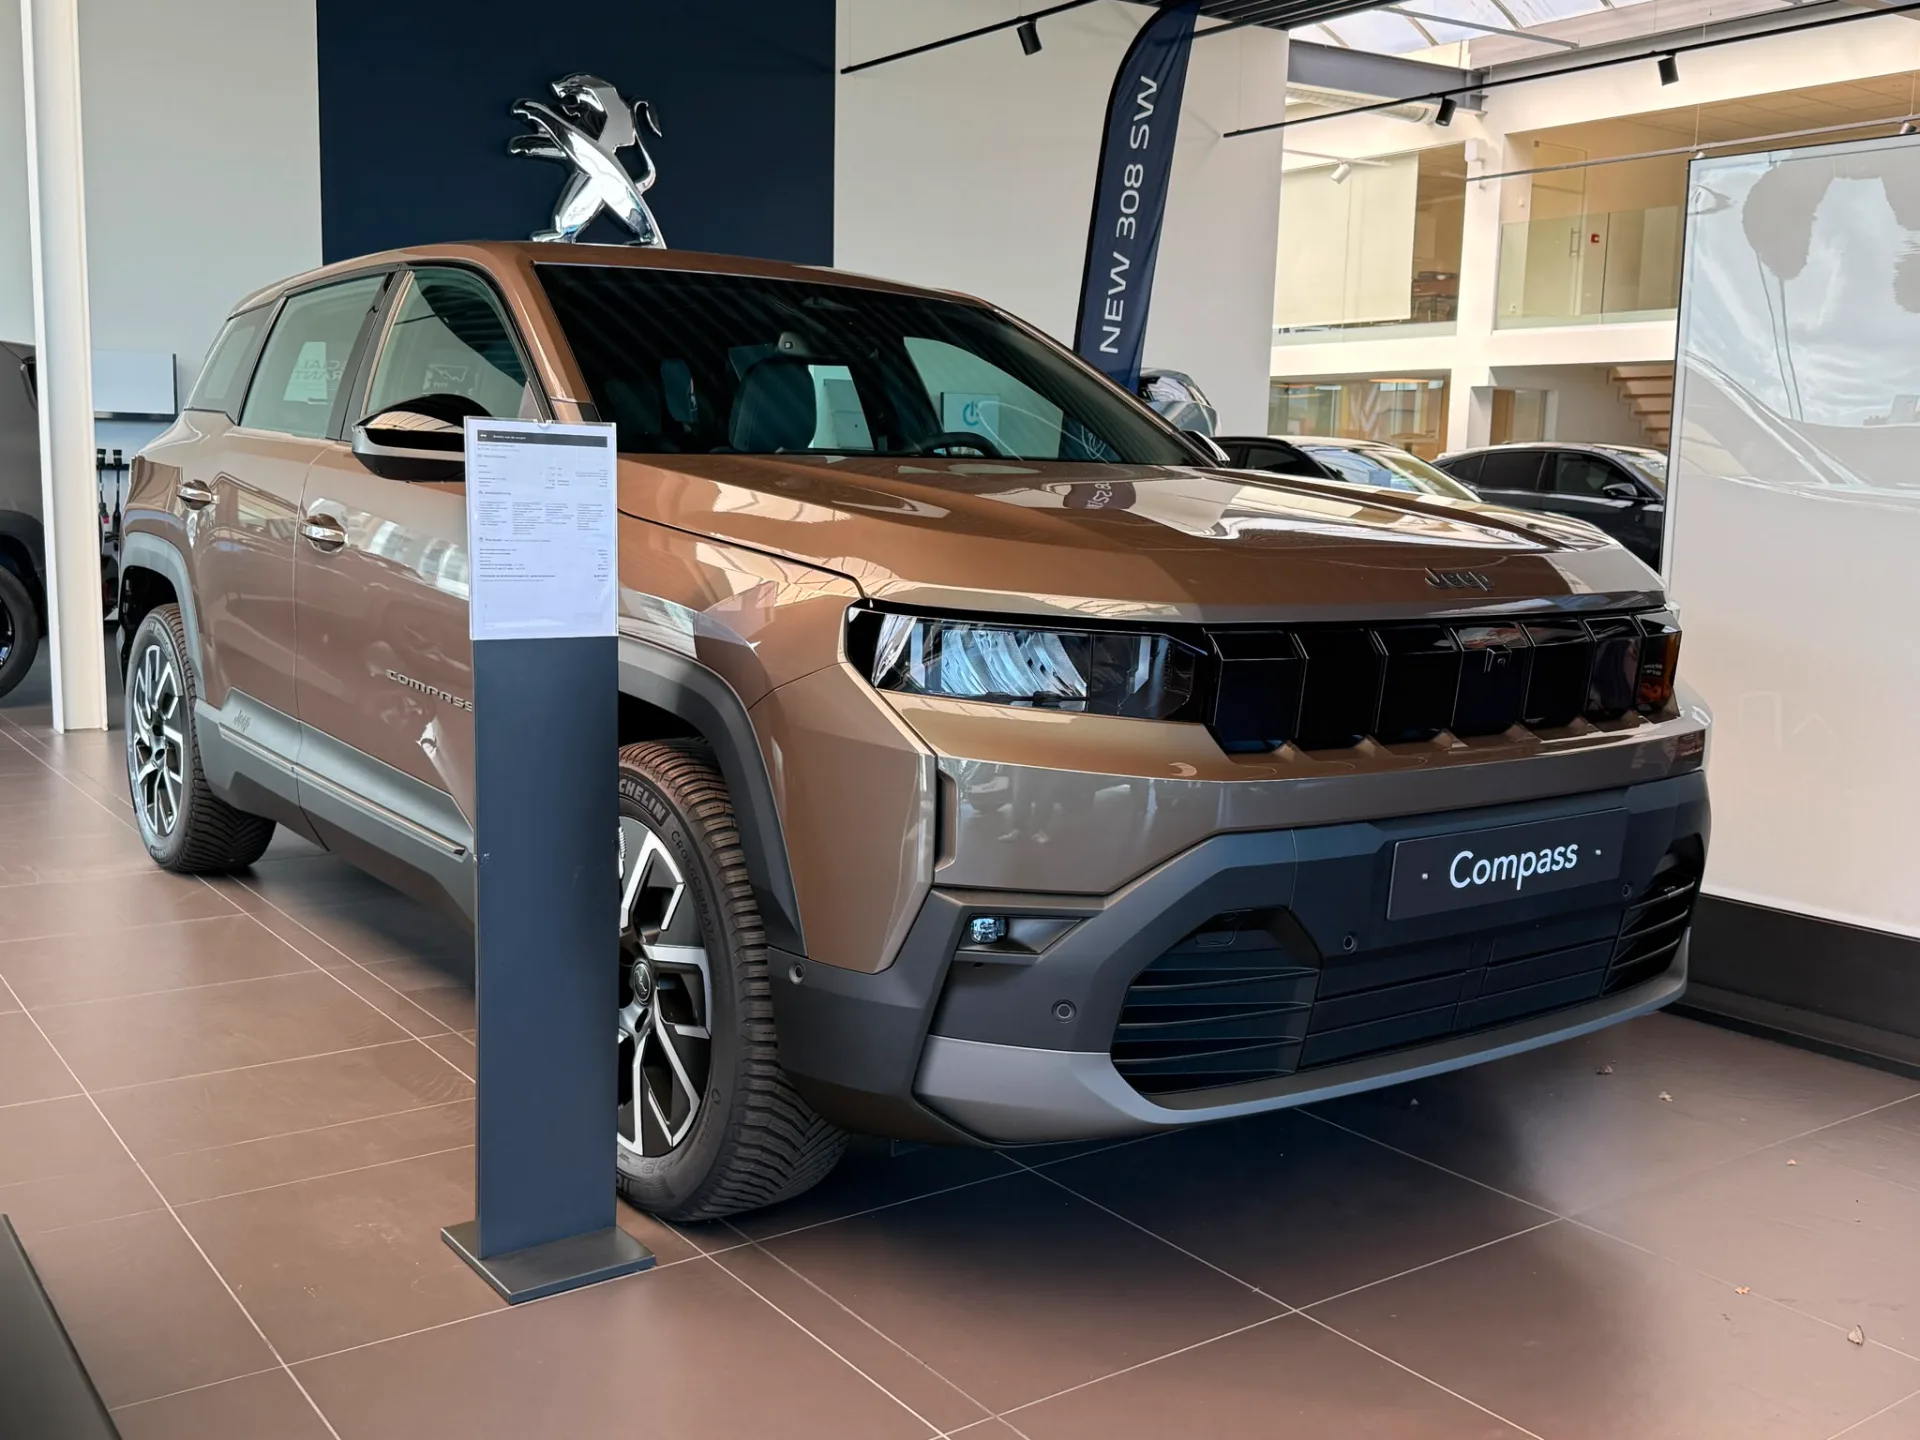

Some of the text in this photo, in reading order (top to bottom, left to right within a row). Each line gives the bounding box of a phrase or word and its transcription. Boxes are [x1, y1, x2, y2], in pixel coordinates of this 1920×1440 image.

[1099, 75, 1158, 354] NEW 308 SW
[1424, 567, 1495, 592] Jeep
[619, 779, 667, 822] CHELIN
[1450, 843, 1578, 890] Compass
